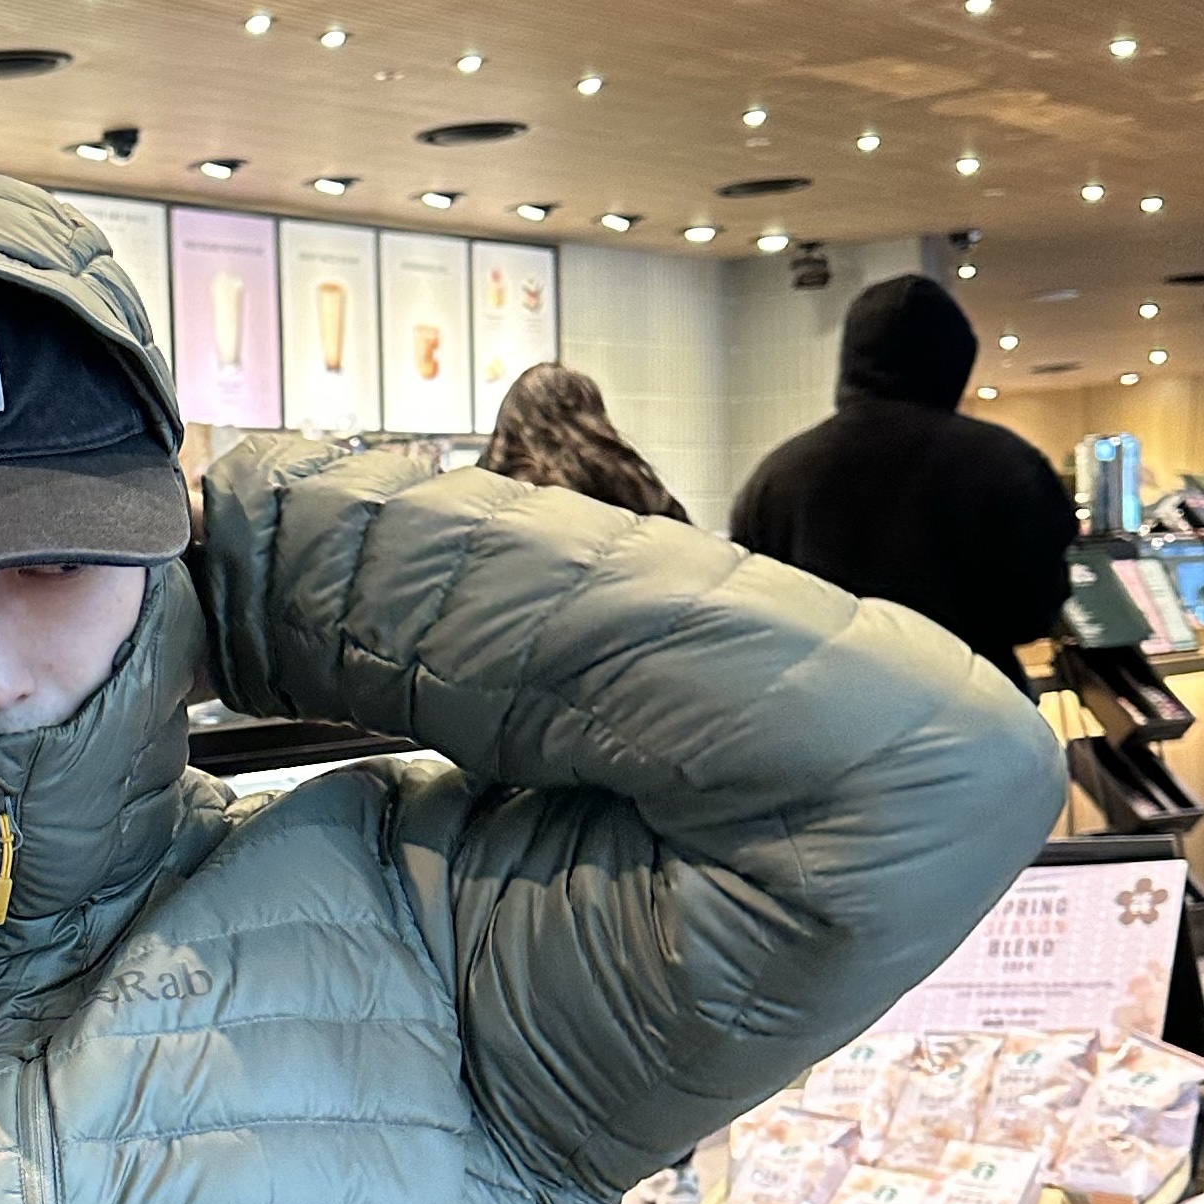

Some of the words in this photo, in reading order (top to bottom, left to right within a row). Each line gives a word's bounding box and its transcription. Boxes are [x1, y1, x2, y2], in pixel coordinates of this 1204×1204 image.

[995, 896, 1068, 916] PRING
[987, 937, 1055, 957] BLEND
[113, 961, 213, 1003] Rab
